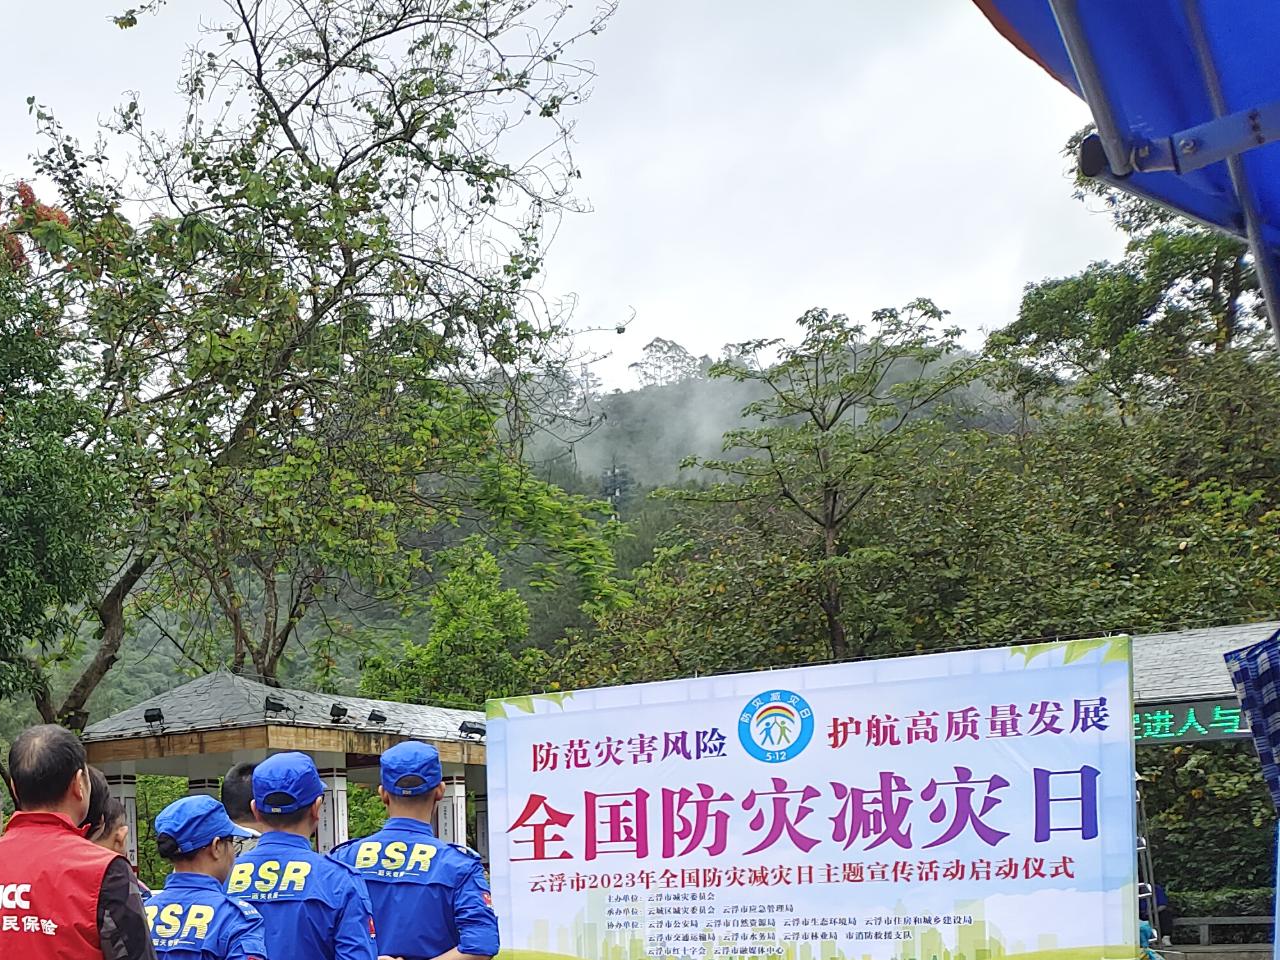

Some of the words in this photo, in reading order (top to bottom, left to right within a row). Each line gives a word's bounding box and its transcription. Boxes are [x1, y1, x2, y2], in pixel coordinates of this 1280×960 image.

[827, 696, 1110, 749] 护航高质量发展
[532, 728, 728, 772] 防范灾害风险
[506, 765, 1101, 861] 全国防灾减灾日
[227, 860, 312, 893] BSR
[355, 841, 437, 872] BSR
[528, 856, 1075, 892] 云浮市2023年全国防灾减灾日主题宣传活动启动仪式
